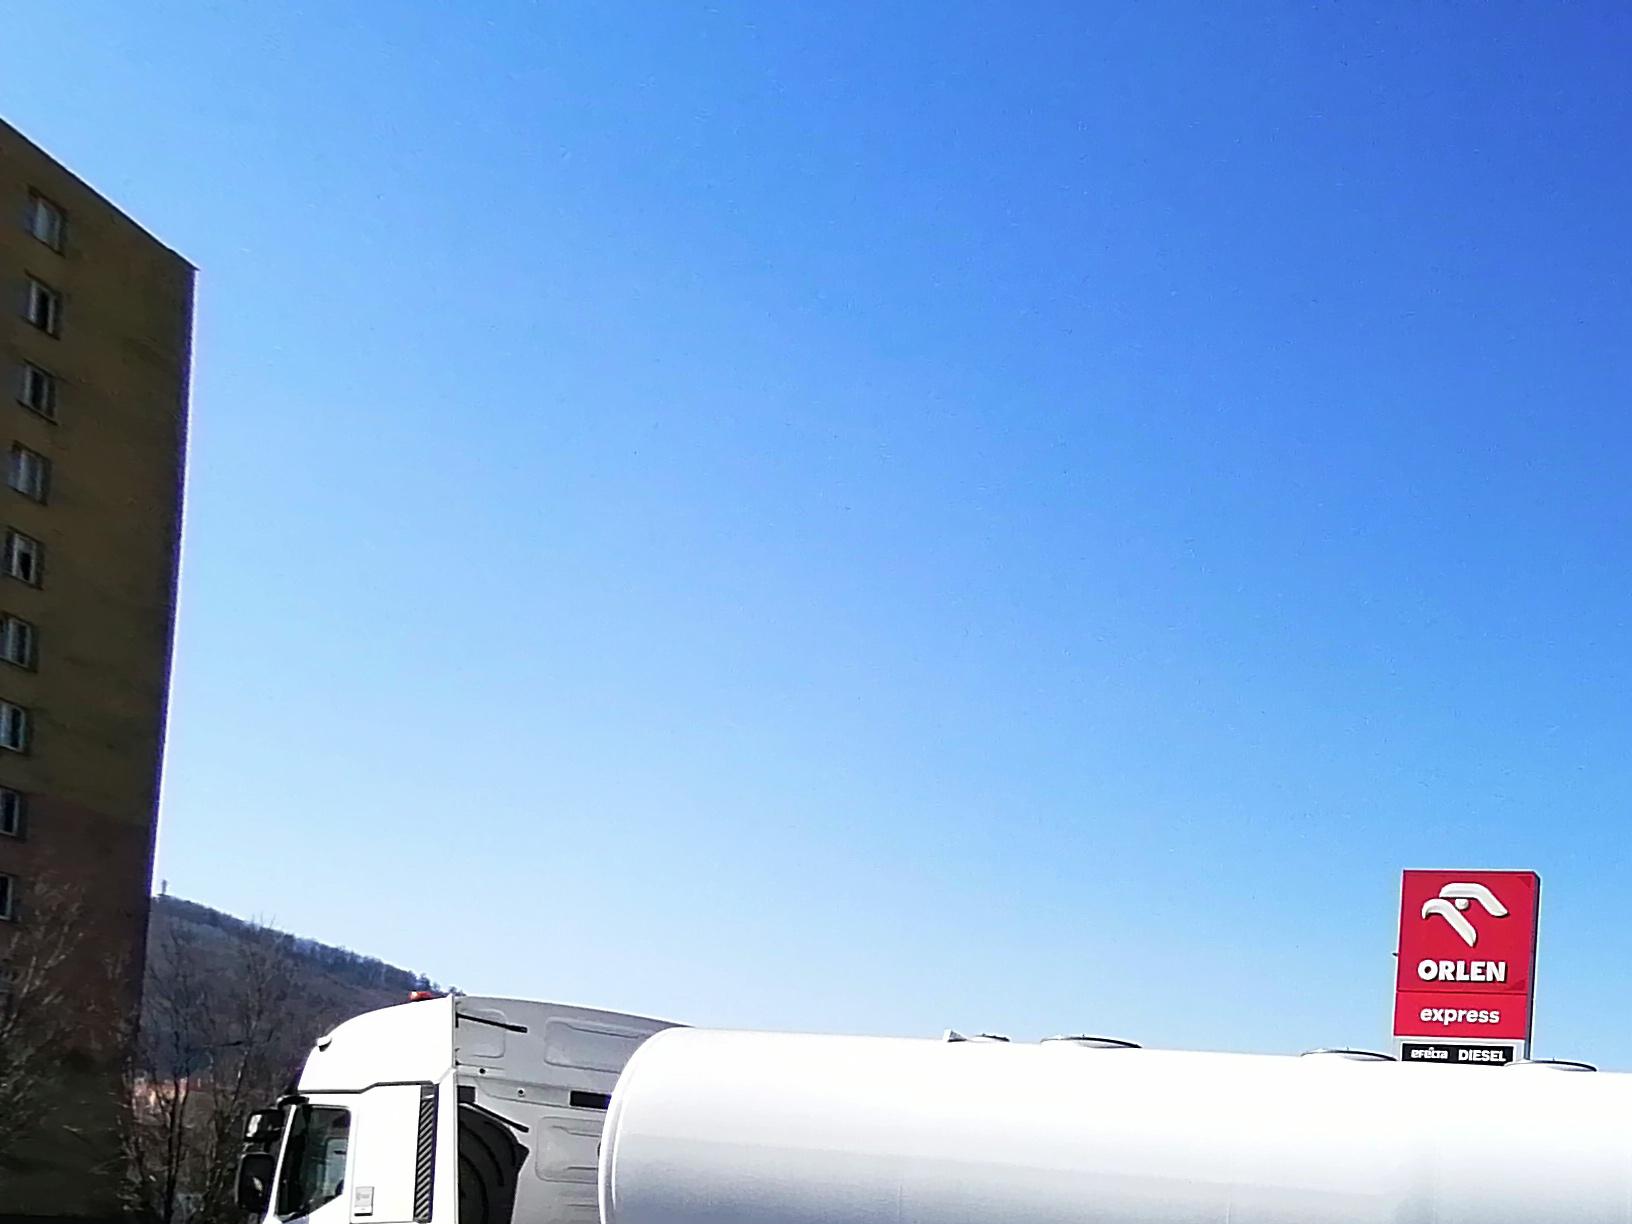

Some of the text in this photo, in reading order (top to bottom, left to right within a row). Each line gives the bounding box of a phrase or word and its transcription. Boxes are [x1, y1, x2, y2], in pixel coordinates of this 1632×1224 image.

[1417, 959, 1506, 982] ORLEN
[1420, 1007, 1500, 1026] express
[1458, 1048, 1507, 1062] DIESEL
